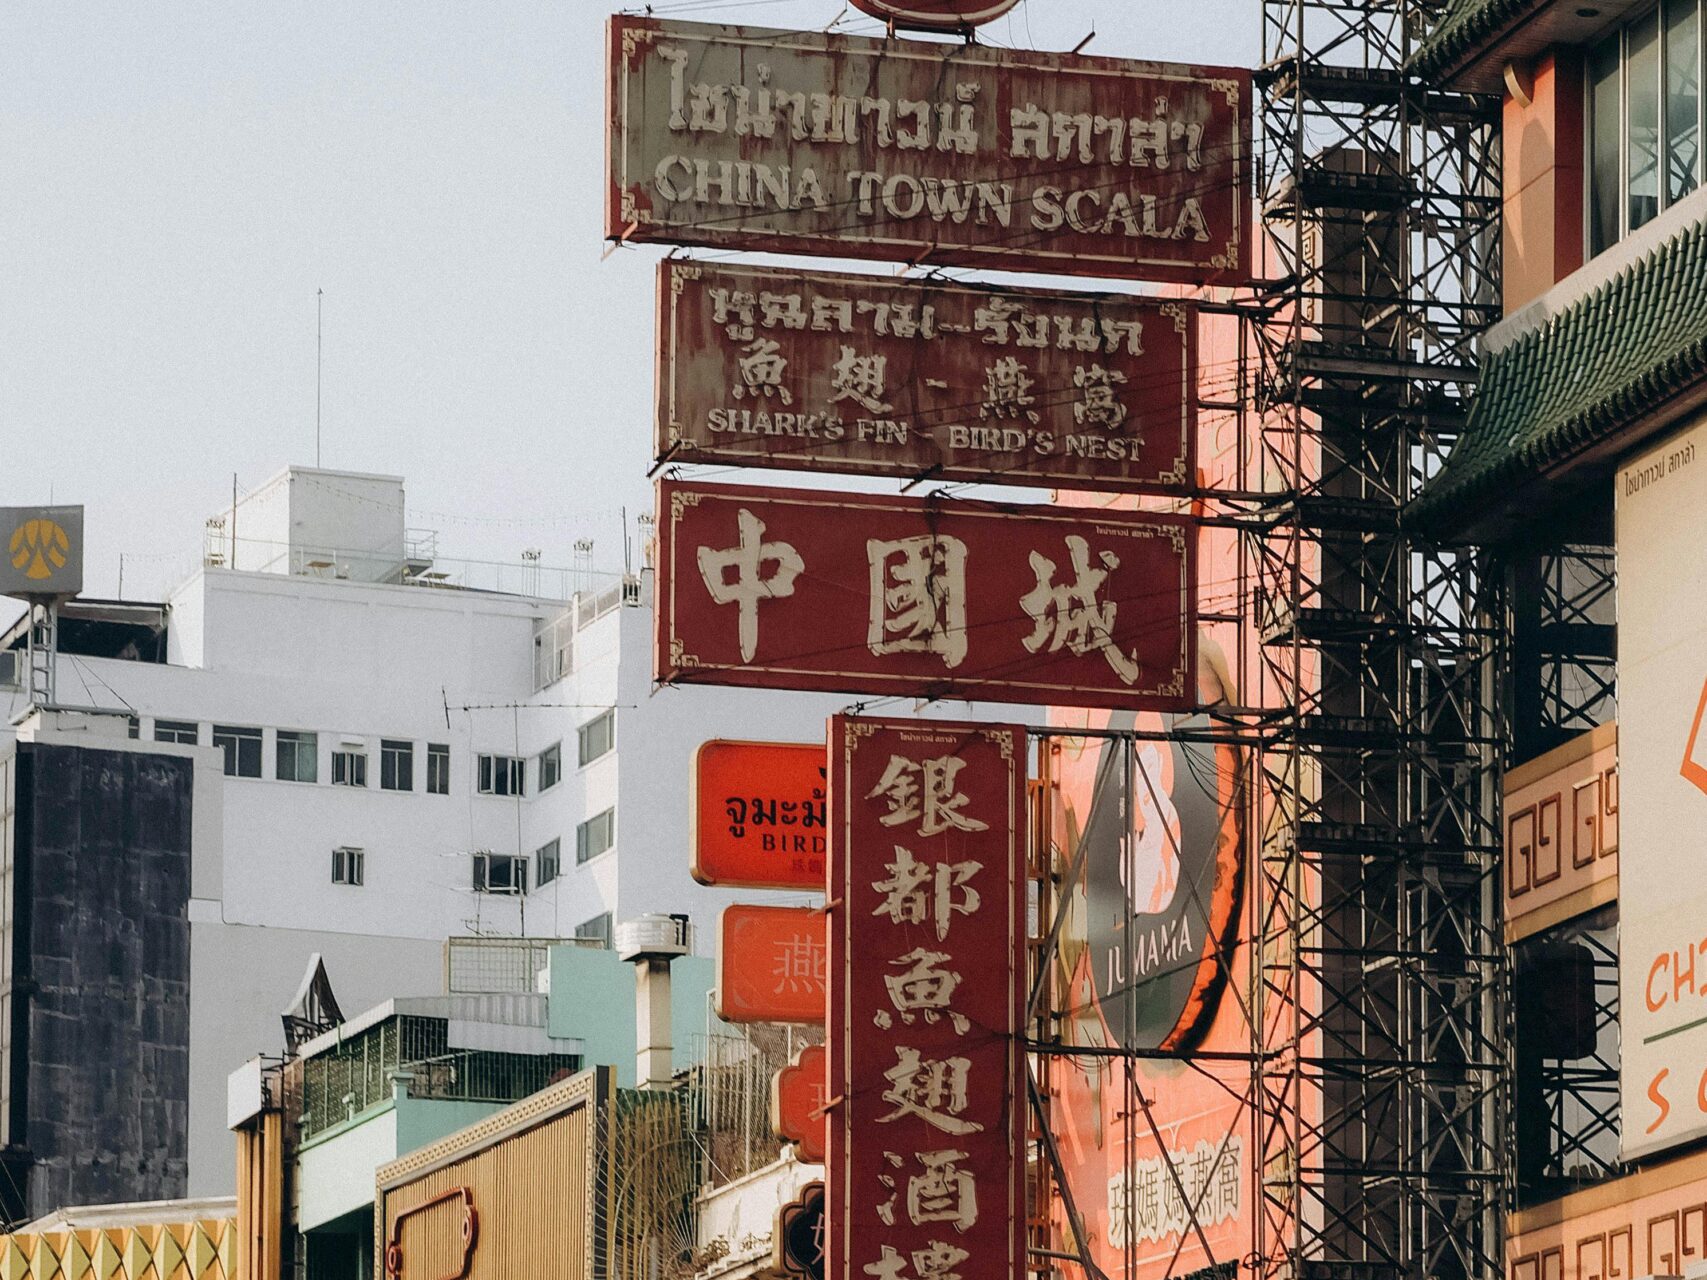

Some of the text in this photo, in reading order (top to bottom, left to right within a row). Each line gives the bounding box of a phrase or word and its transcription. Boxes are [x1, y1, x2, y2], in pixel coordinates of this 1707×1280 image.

[1009, 96, 1204, 171] สกาล่า
[654, 154, 1210, 242] CHINA TOWN SCALA
[708, 408, 845, 439] SHARK'S
[857, 418, 908, 445] FIN
[948, 425, 1054, 456] BIRD'S
[1065, 435, 1145, 462] NEST
[697, 508, 1141, 686] 中國城
[762, 834, 826, 853] BIRD
